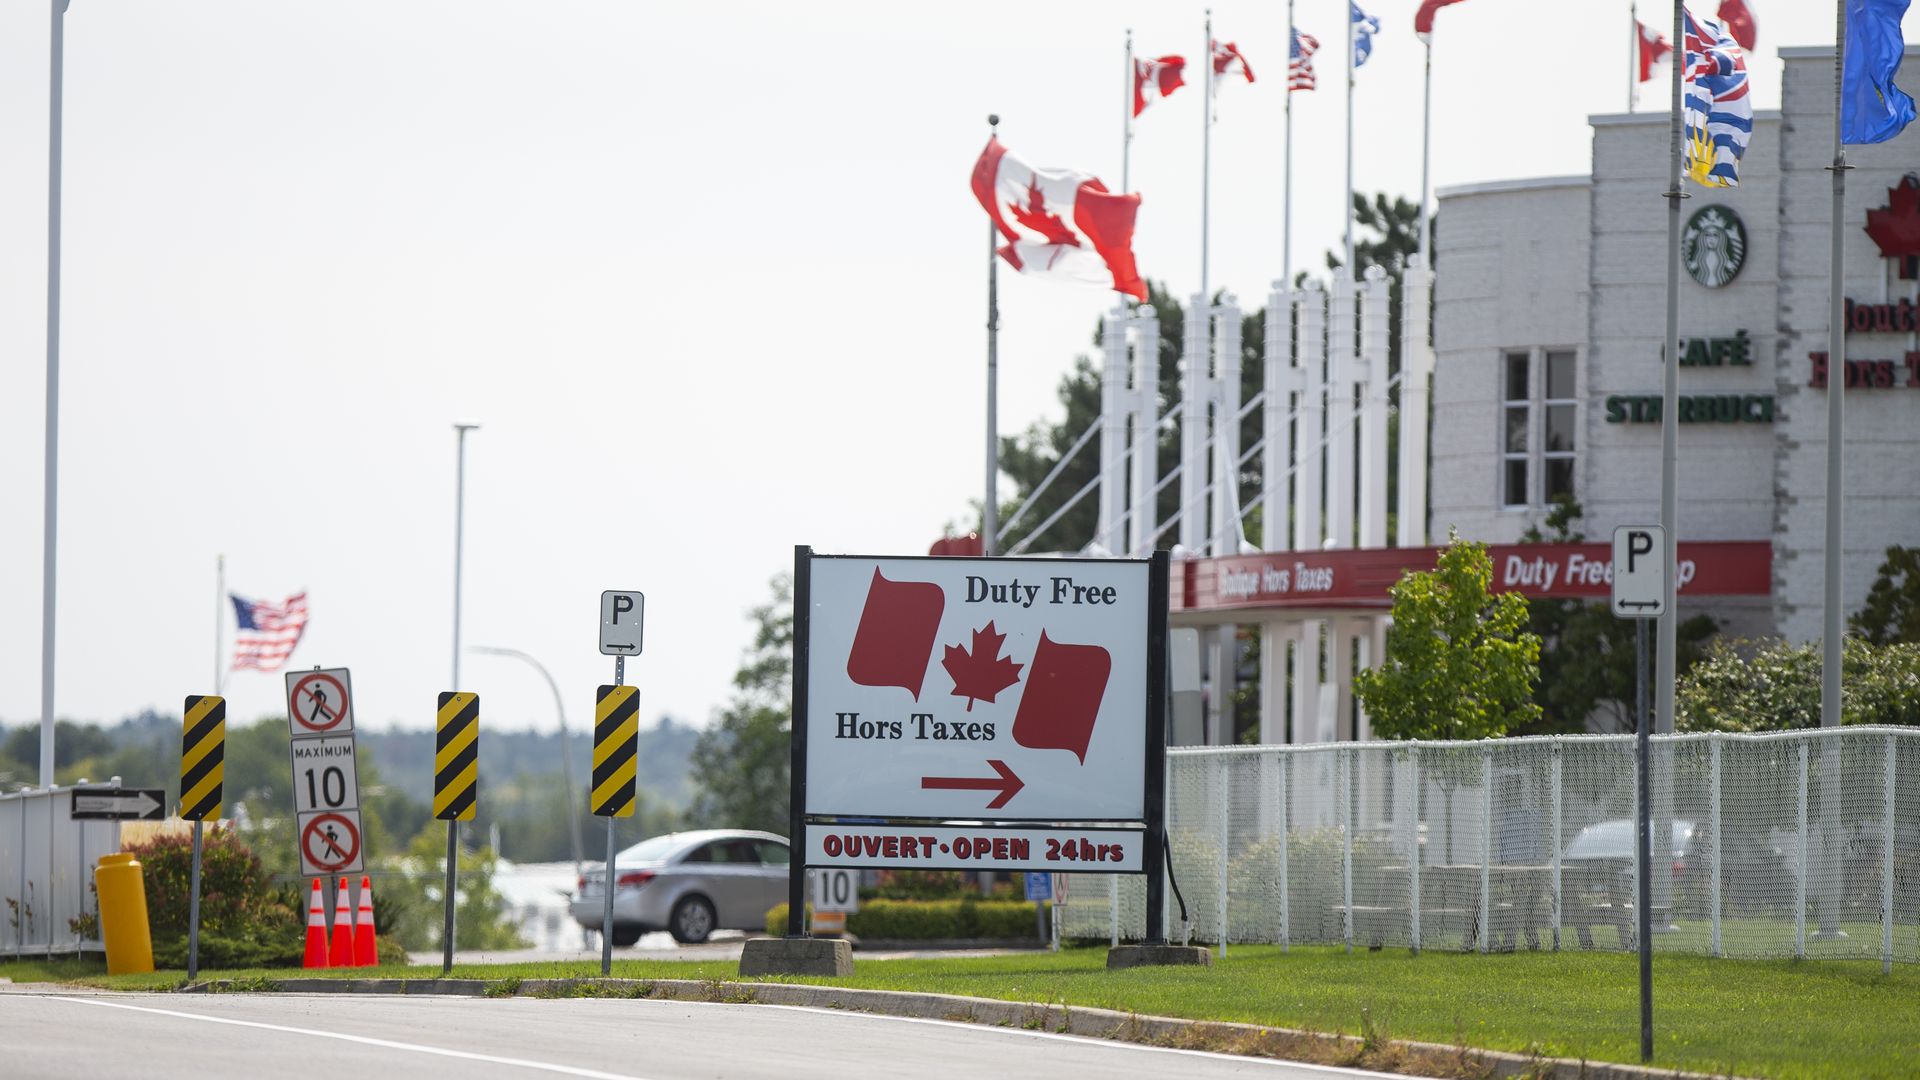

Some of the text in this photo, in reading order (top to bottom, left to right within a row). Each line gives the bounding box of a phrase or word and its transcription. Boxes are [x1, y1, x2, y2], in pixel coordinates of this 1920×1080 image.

[1628, 531, 1653, 573] P
[1263, 563, 1290, 592] Hors
[1294, 561, 1333, 591] Taxes
[1504, 555, 1558, 592] Duty
[965, 576, 1117, 608] Duty Free
[613, 596, 634, 625] P
[835, 713, 996, 740] Hors Taxes
[295, 745, 351, 759] MAXIMUM
[305, 766, 346, 809] 10
[1046, 838, 1124, 862] 24hrs
[822, 871, 849, 905] 10
